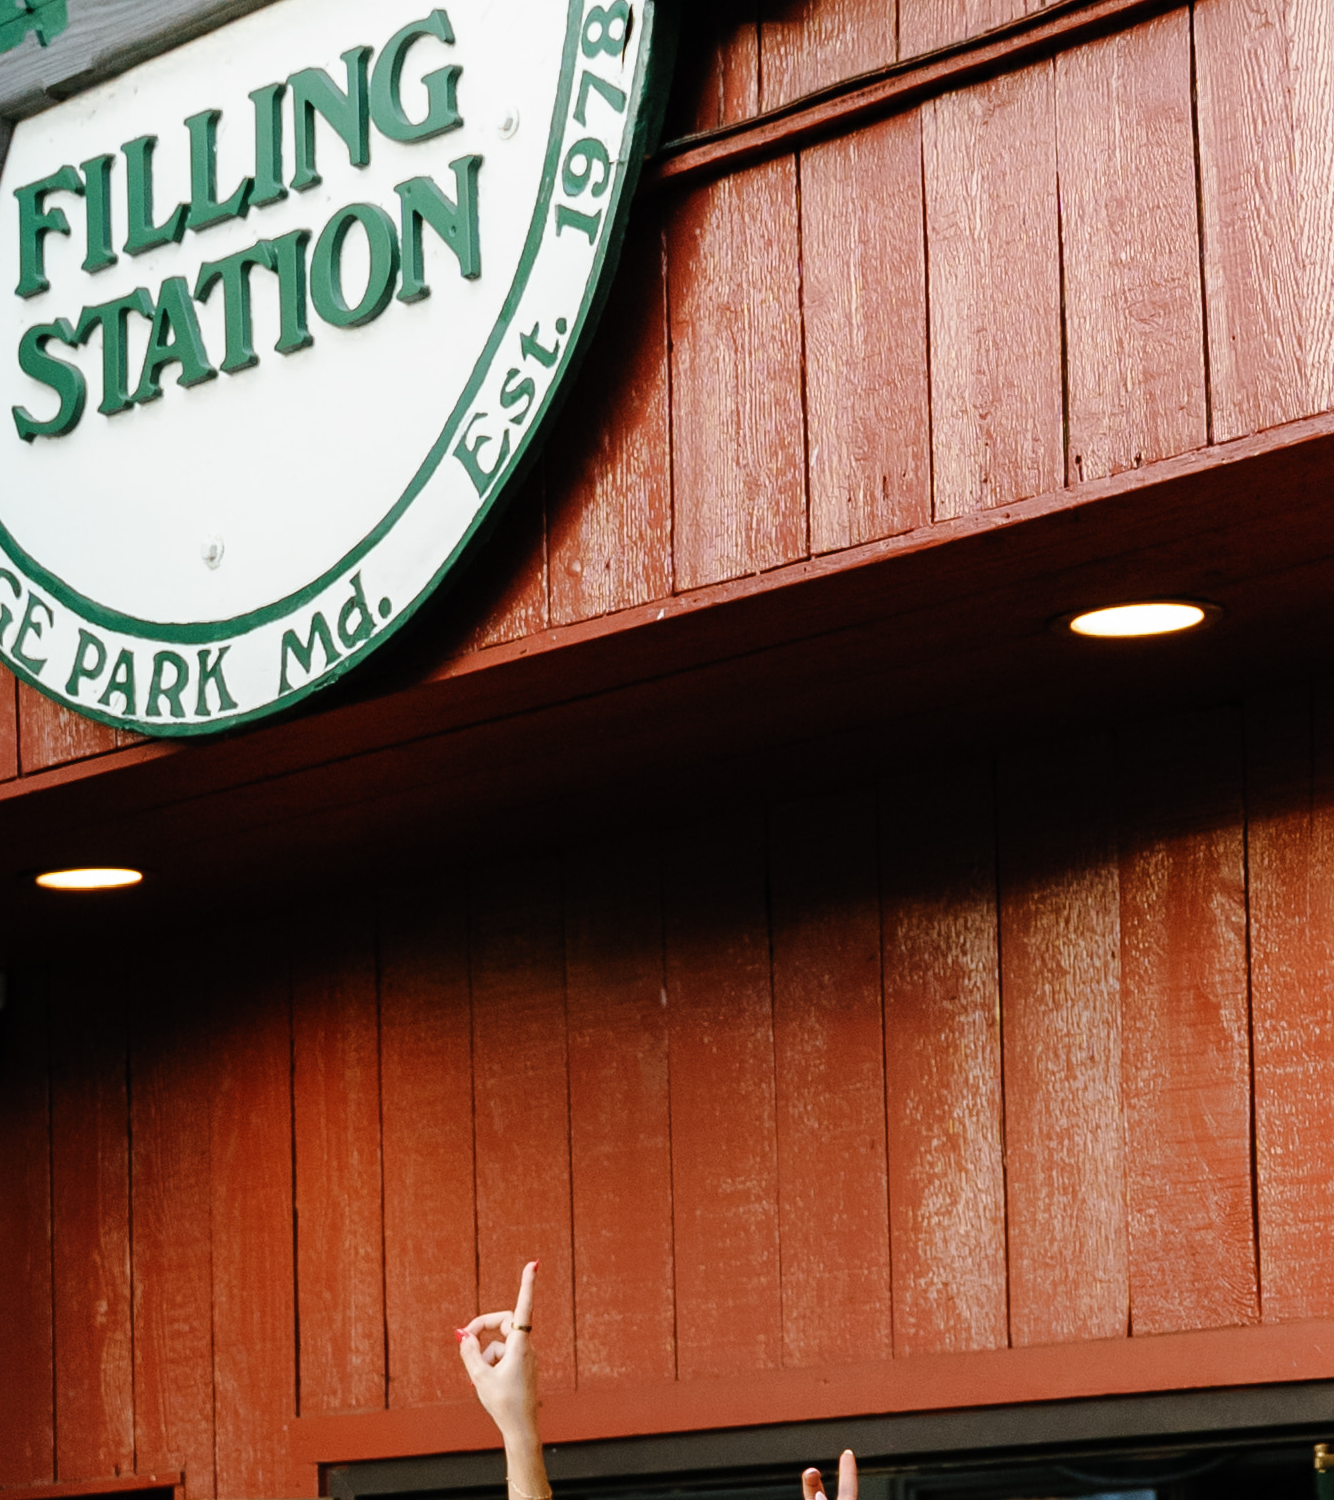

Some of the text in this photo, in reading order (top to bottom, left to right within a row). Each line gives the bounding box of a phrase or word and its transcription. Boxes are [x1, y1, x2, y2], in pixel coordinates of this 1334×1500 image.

[12, 8, 464, 300] FILLING
[11, 154, 484, 443] STATION
[452, 317, 567, 499] Est.
[66, 628, 238, 717] PARK
[278, 569, 393, 697] Md.
